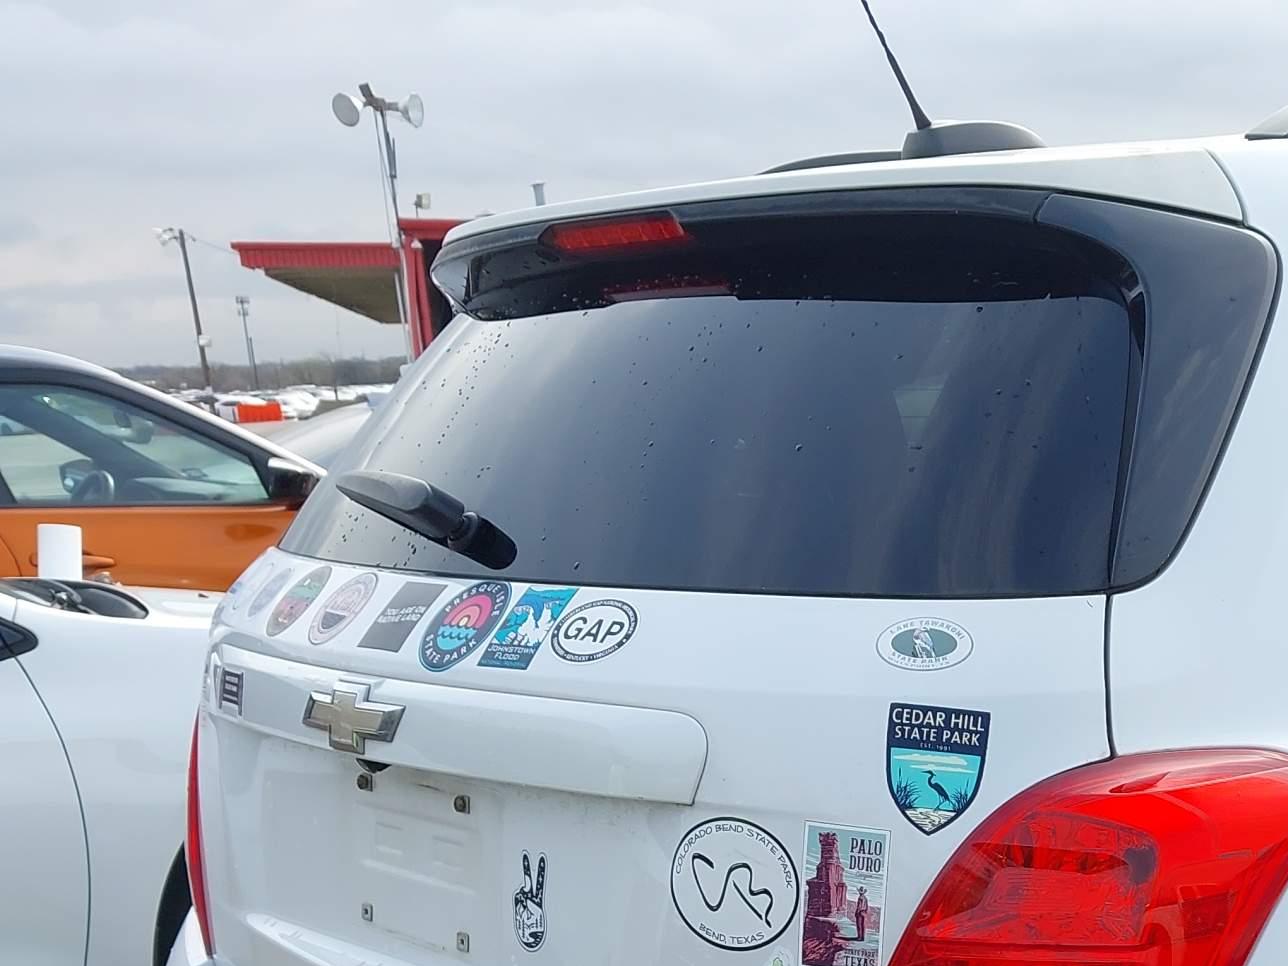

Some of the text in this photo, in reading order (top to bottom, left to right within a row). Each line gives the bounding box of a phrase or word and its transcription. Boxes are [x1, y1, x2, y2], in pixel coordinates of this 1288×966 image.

[563, 616, 625, 644] GAP
[425, 634, 477, 664] STATE PARK
[892, 707, 986, 732] CEDAR HILL
[894, 725, 981, 747] STATE PARK
[676, 823, 794, 889] COLORADO BEND STATE PARK
[850, 837, 883, 856] PALO
[849, 854, 881, 873] DURO
[729, 931, 765, 945] TEXAS
